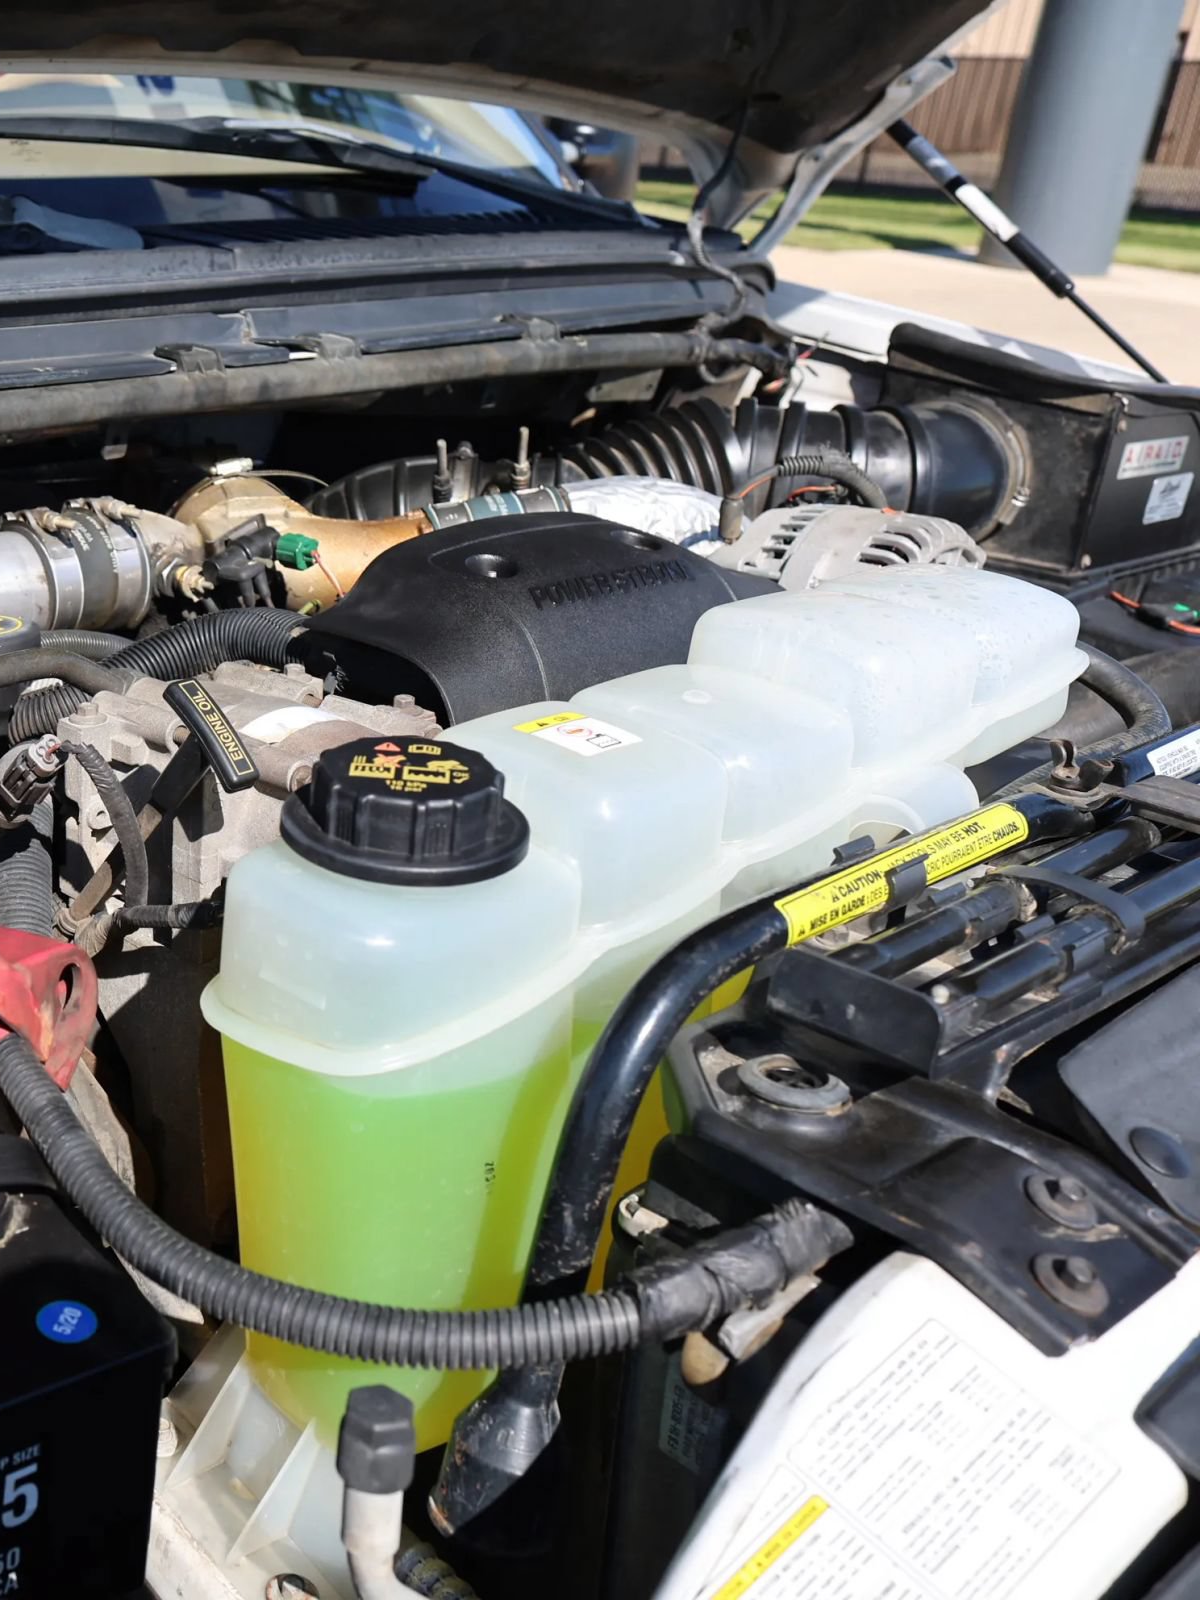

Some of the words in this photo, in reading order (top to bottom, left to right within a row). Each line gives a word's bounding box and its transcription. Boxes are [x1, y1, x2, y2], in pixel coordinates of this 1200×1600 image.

[193, 691, 212, 711] OIL
[206, 712, 244, 761] ENGINE
[934, 836, 953, 850] MAY
[952, 830, 965, 842] BE
[961, 821, 986, 837] HOT.
[830, 907, 840, 922] EN
[841, 895, 865, 916] GARDE
[12, 1443, 42, 1466] SIZE
